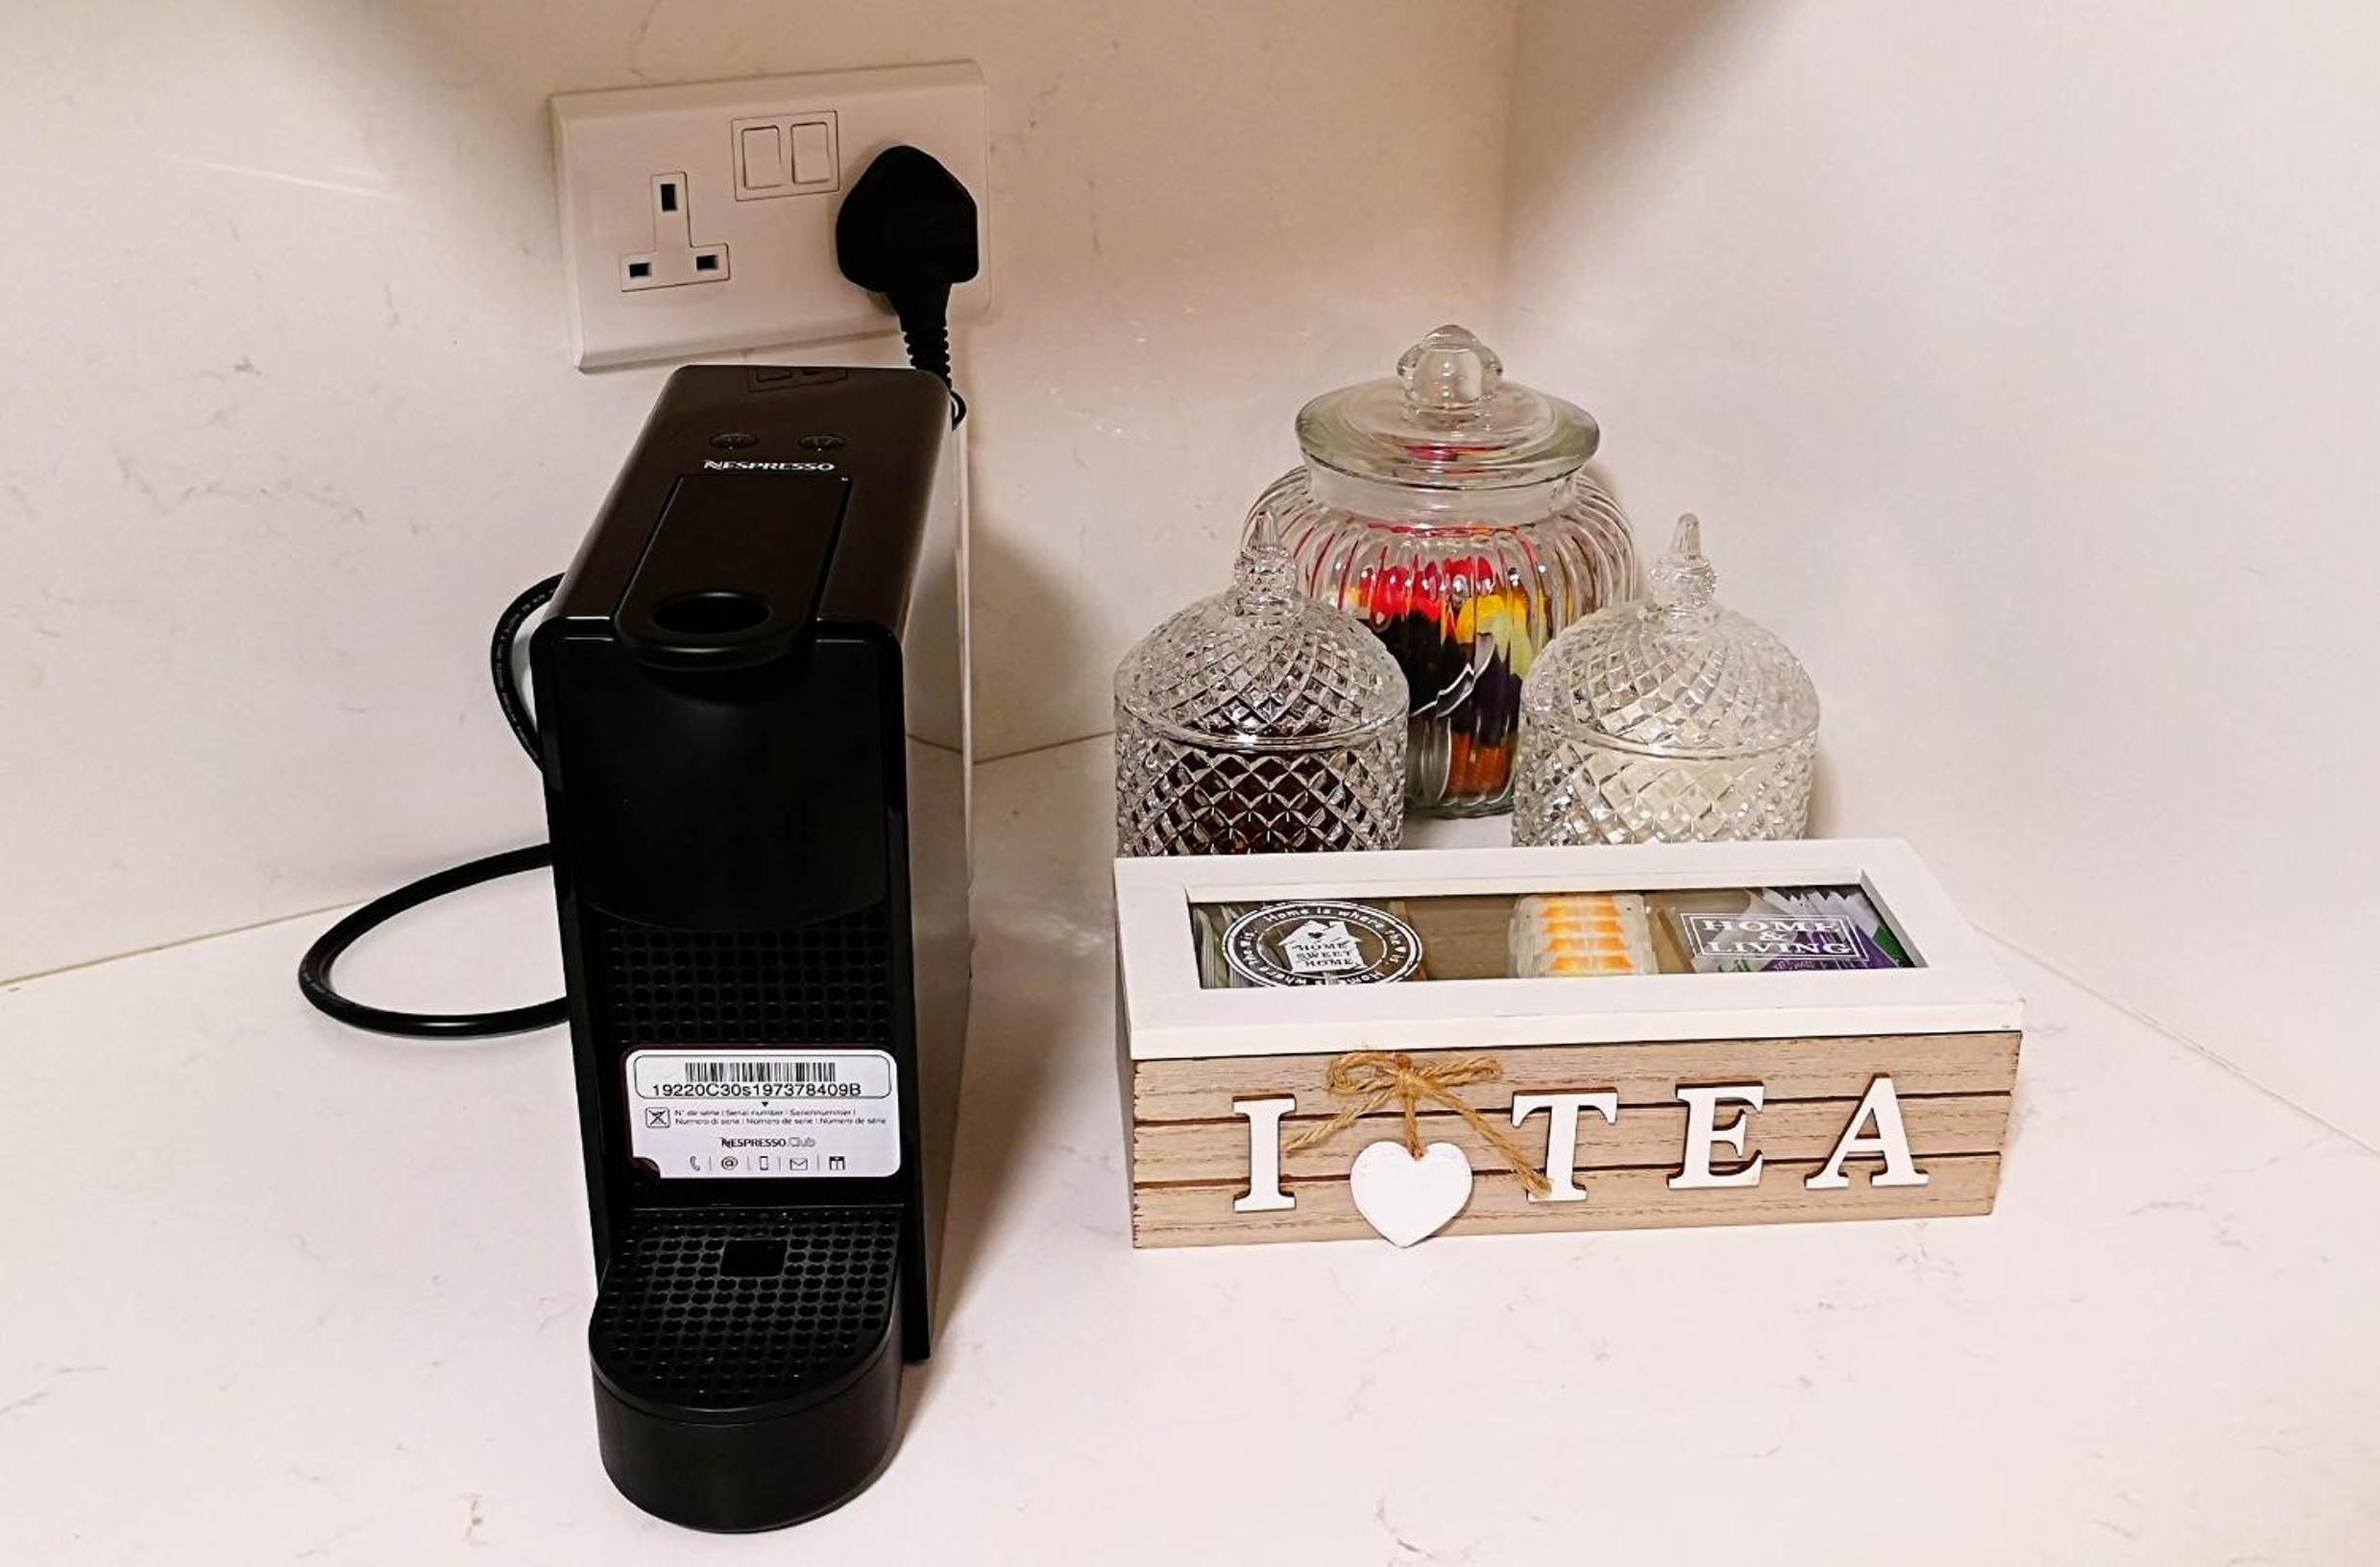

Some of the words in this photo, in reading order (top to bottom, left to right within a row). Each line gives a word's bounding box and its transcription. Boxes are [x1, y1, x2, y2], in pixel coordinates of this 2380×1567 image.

[704, 459, 836, 471] NESPRESSO
[1263, 908, 1309, 922] Home
[1702, 919, 1839, 932] HOME
[1760, 929, 1788, 942] &
[1708, 941, 1853, 954] LIVING
[1297, 951, 1351, 959] SWEET
[652, 1083, 862, 1097] 19220C30s197378409B
[1232, 1093, 1297, 1213] I
[1511, 1072, 1930, 1203] TEA
